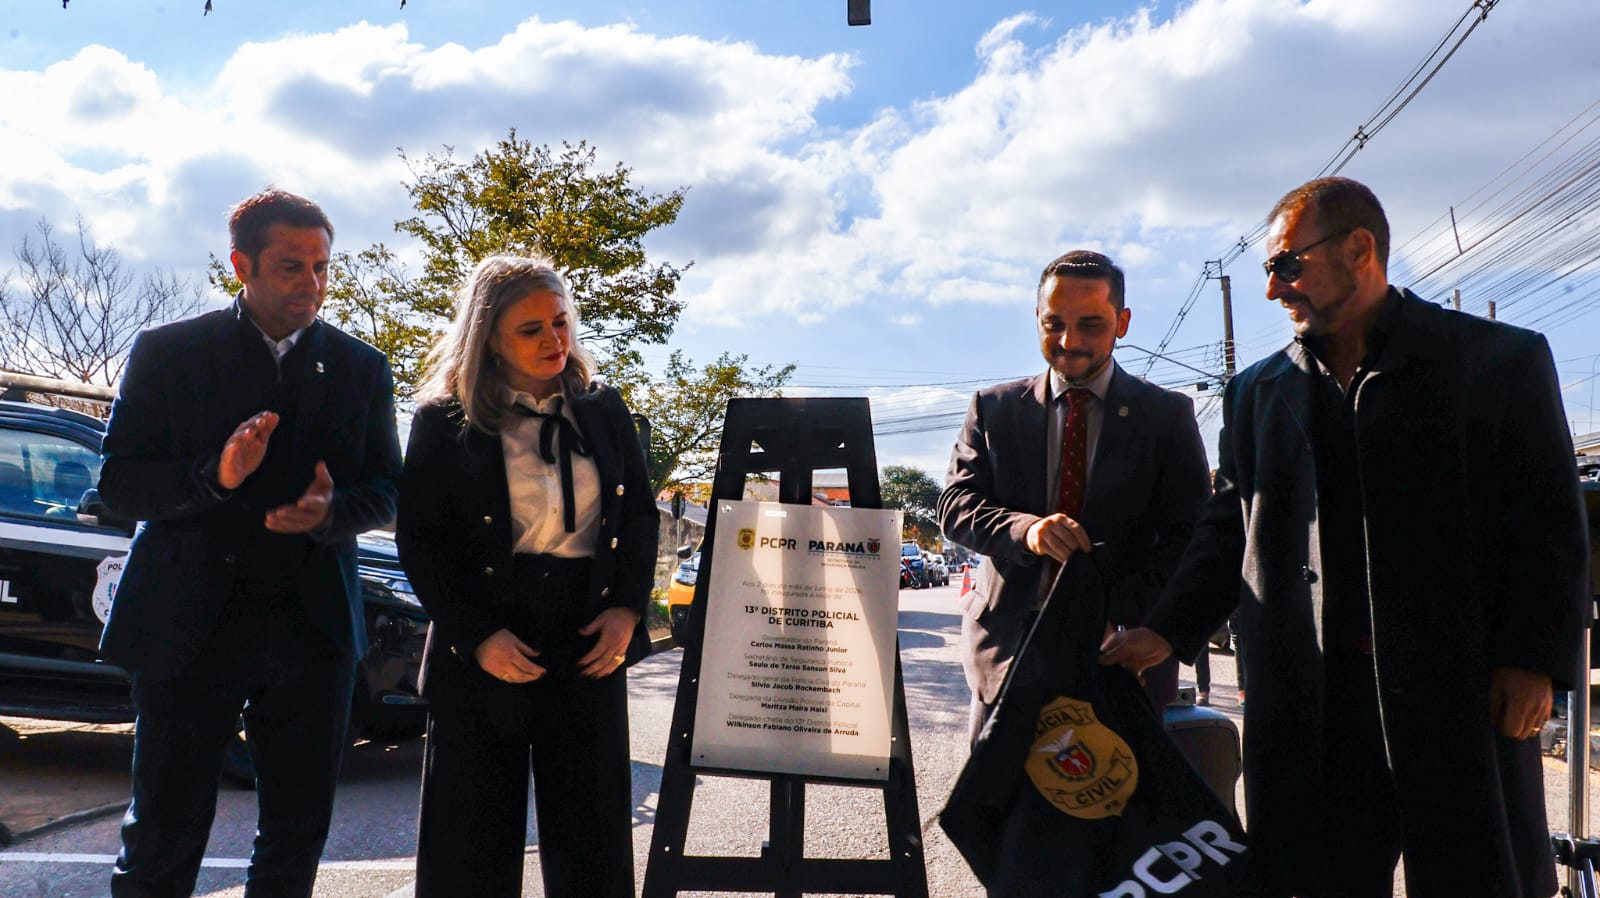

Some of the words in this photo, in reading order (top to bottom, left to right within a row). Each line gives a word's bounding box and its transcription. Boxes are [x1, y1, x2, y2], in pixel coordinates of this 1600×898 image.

[760, 536, 797, 551] PCPR
[808, 540, 866, 554] PARANÁ
[761, 606, 809, 618] DISTRITO
[811, 610, 860, 621] POLICIAL
[768, 616, 782, 625] DE
[785, 617, 834, 629] CURITIBA
[762, 634, 801, 643] Governador
[801, 636, 813, 644] do
[814, 637, 838, 646] Paraná
[750, 640, 773, 648] Carlos
[774, 641, 796, 650] Massa
[797, 643, 824, 652] Ratinho
[825, 645, 848, 654] Junior
[743, 653, 778, 662] Secretário
[779, 655, 790, 663] de
[790, 655, 826, 666] Segurança
[749, 661, 769, 669] Saulo
[781, 663, 801, 671] Tarso
[802, 664, 828, 673] Sanson
[829, 666, 847, 674] Silva
[751, 681, 771, 689] Silvio
[772, 682, 794, 690] Jacob
[795, 684, 841, 694] Rockembach
[779, 675, 791, 683] da
[814, 677, 831, 686] Civil
[831, 678, 842, 687] do
[843, 679, 867, 688] Paraná
[761, 703, 788, 711] Maritza
[788, 704, 809, 712] Maira
[773, 695, 799, 704] Divisão
[836, 700, 862, 709] Capital
[726, 720, 762, 730] Wilkinson
[762, 723, 792, 732] Fabiano
[793, 724, 822, 734] Oliveira
[823, 726, 832, 734] de
[834, 727, 859, 737] Arruda
[806, 718, 831, 727] Distrito
[833, 720, 858, 729] Policial
[1075, 777, 1122, 805] CIVIL
